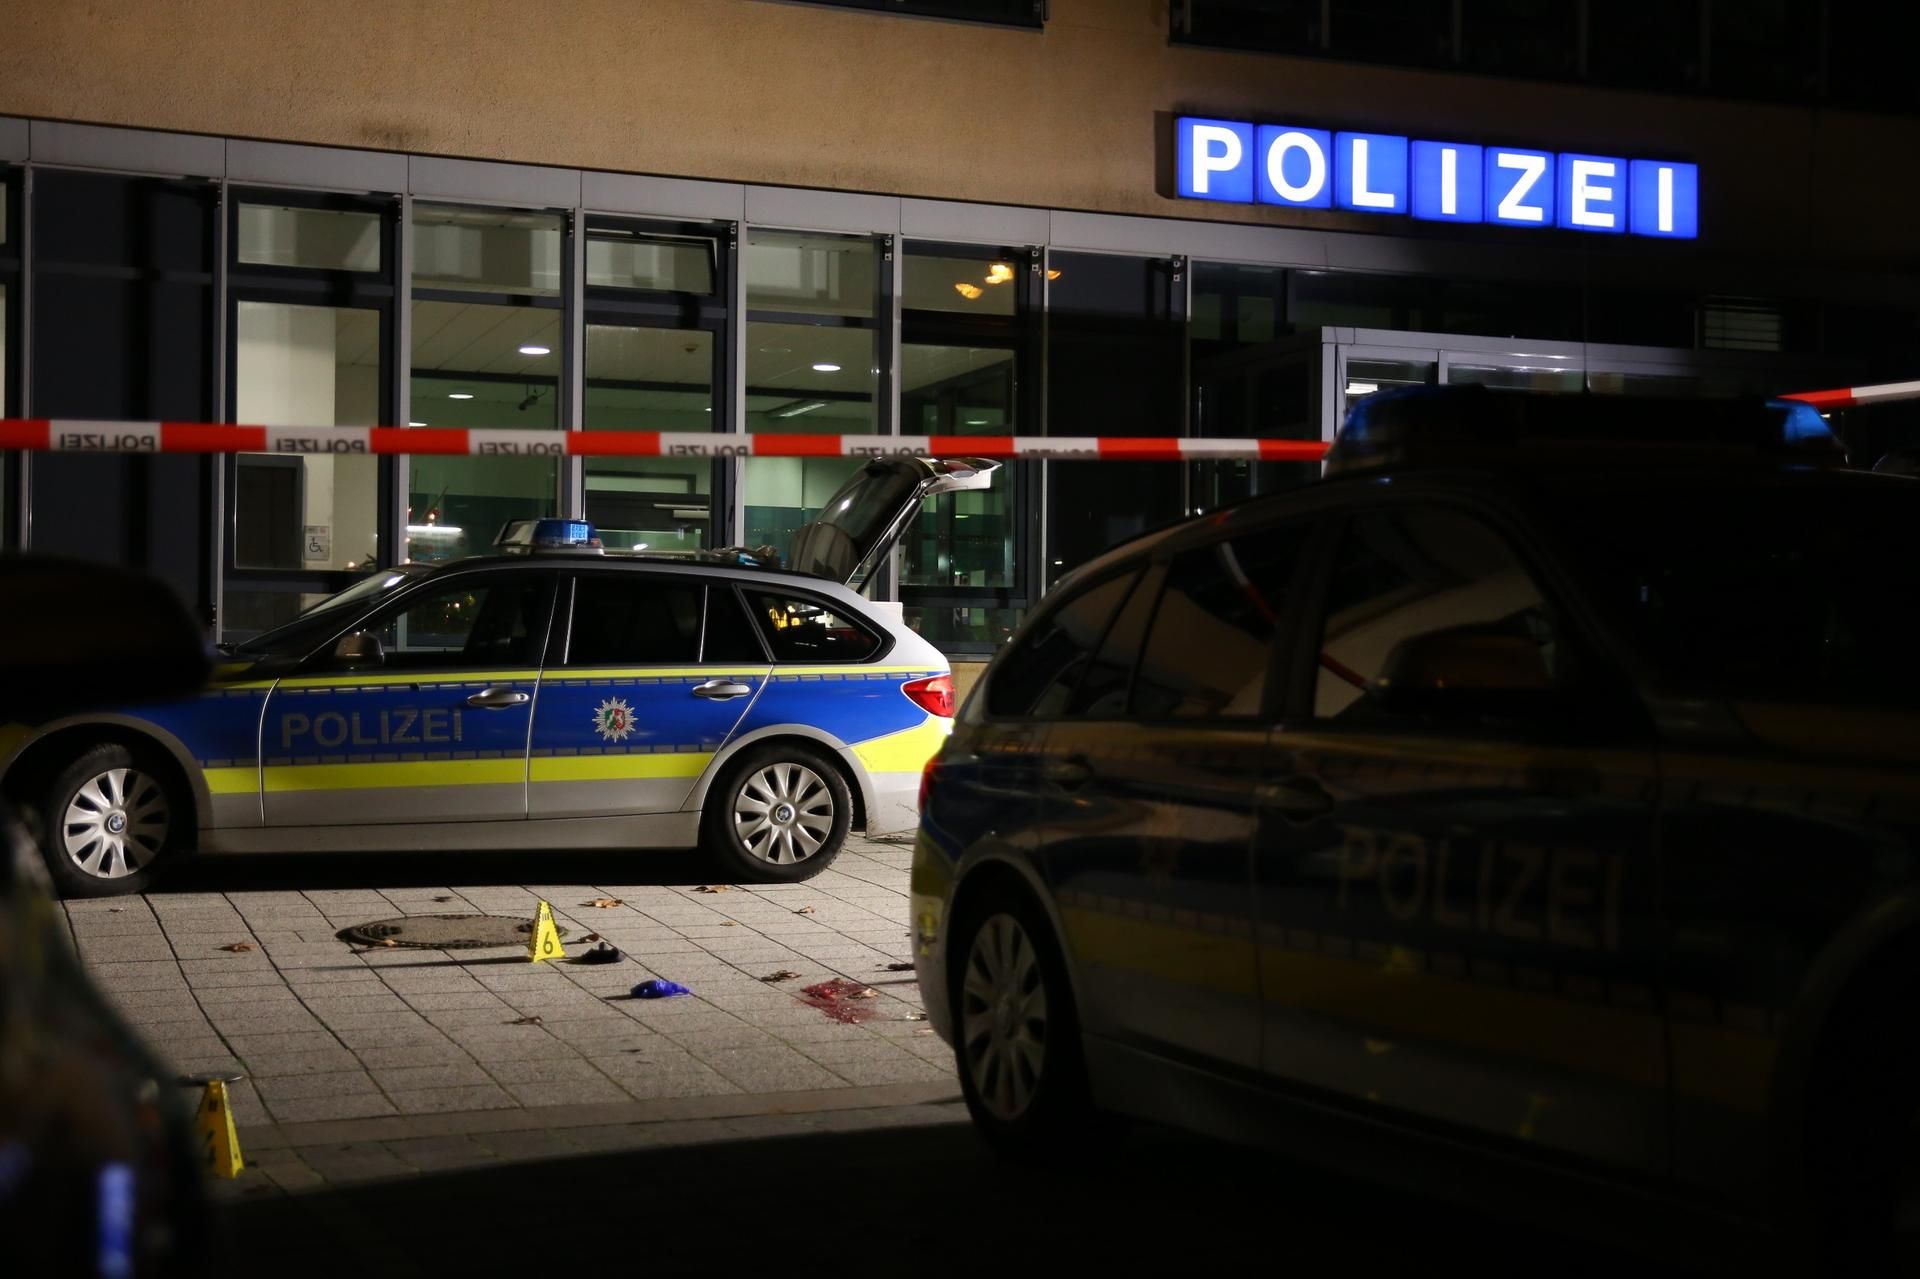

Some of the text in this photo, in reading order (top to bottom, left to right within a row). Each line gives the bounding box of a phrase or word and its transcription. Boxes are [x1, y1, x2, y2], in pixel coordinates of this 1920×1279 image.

[1192, 124, 1673, 232] POLIZEI
[280, 708, 462, 749] POLIZEI
[1338, 824, 1623, 952] POLIZEI
[543, 931, 553, 955] 6
